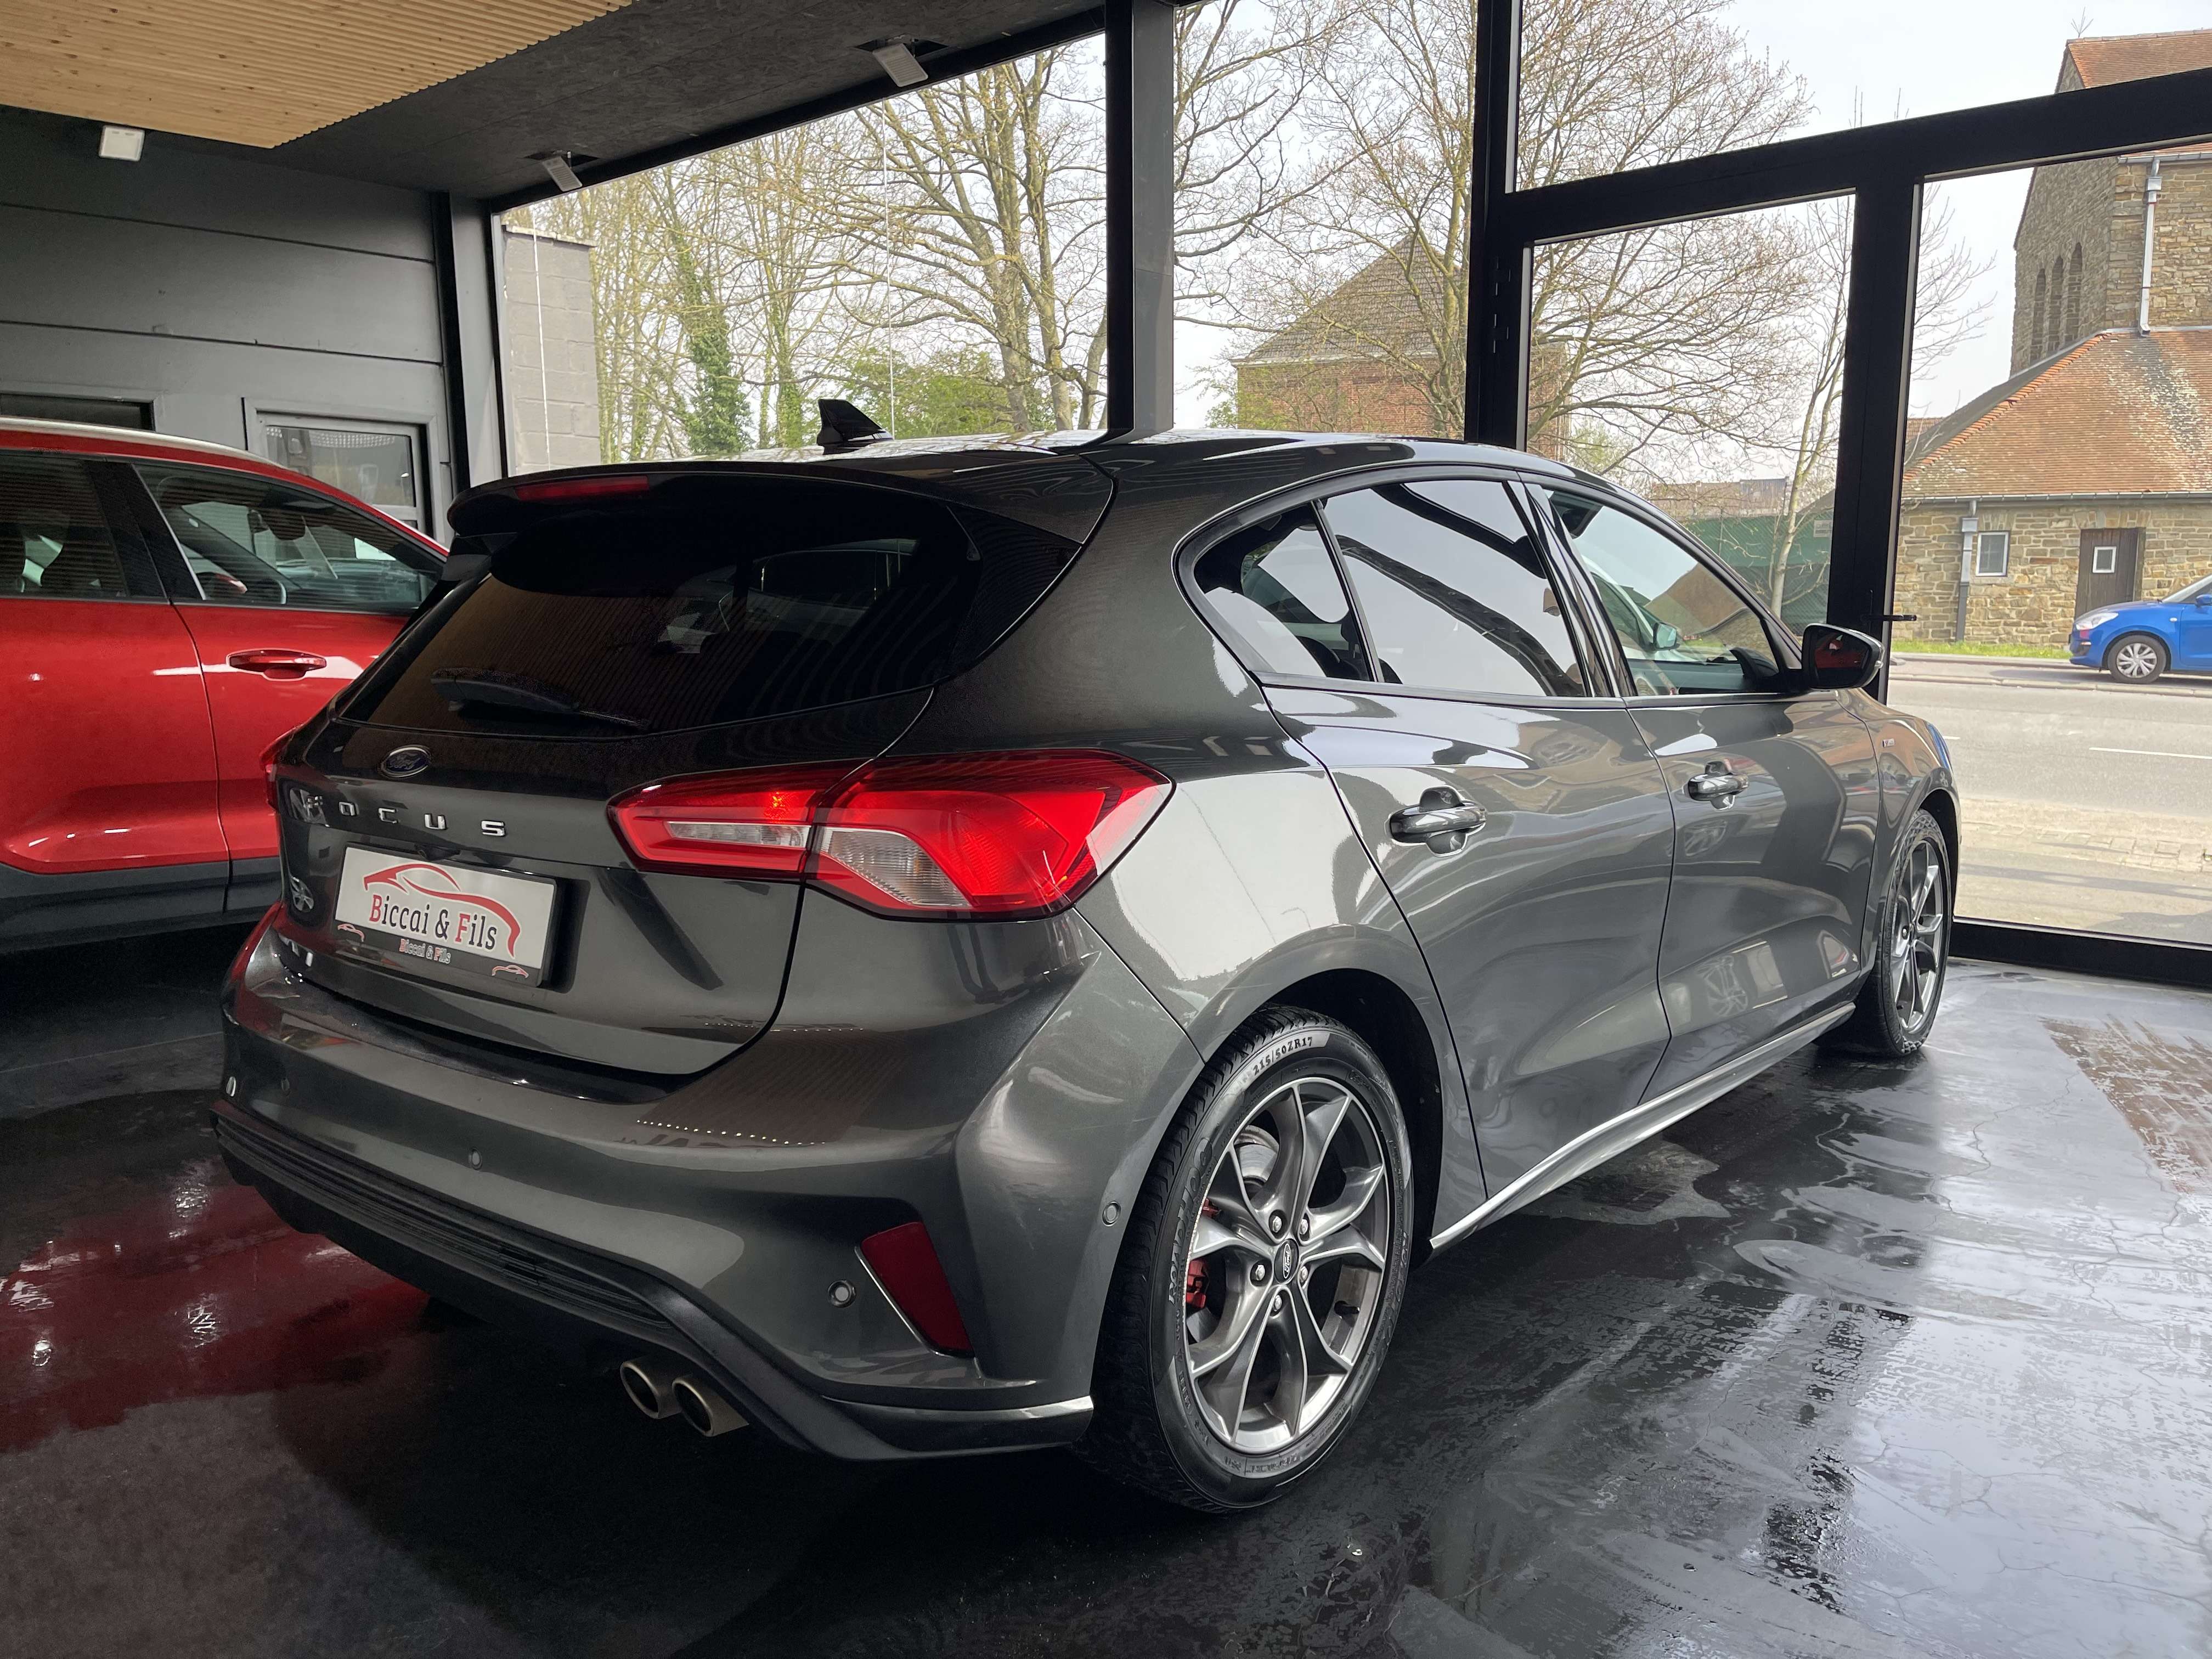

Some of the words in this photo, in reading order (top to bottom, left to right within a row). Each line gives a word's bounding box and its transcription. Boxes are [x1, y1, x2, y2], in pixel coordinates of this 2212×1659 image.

[369, 894, 430, 934] Biccai
[435, 909, 449, 940] &
[455, 913, 497, 950] Fils
[399, 938, 426, 957] Biccai
[426, 945, 434, 960] &
[434, 947, 452, 964] Fils
[1253, 1036, 1313, 1076] 215/50ZR17
